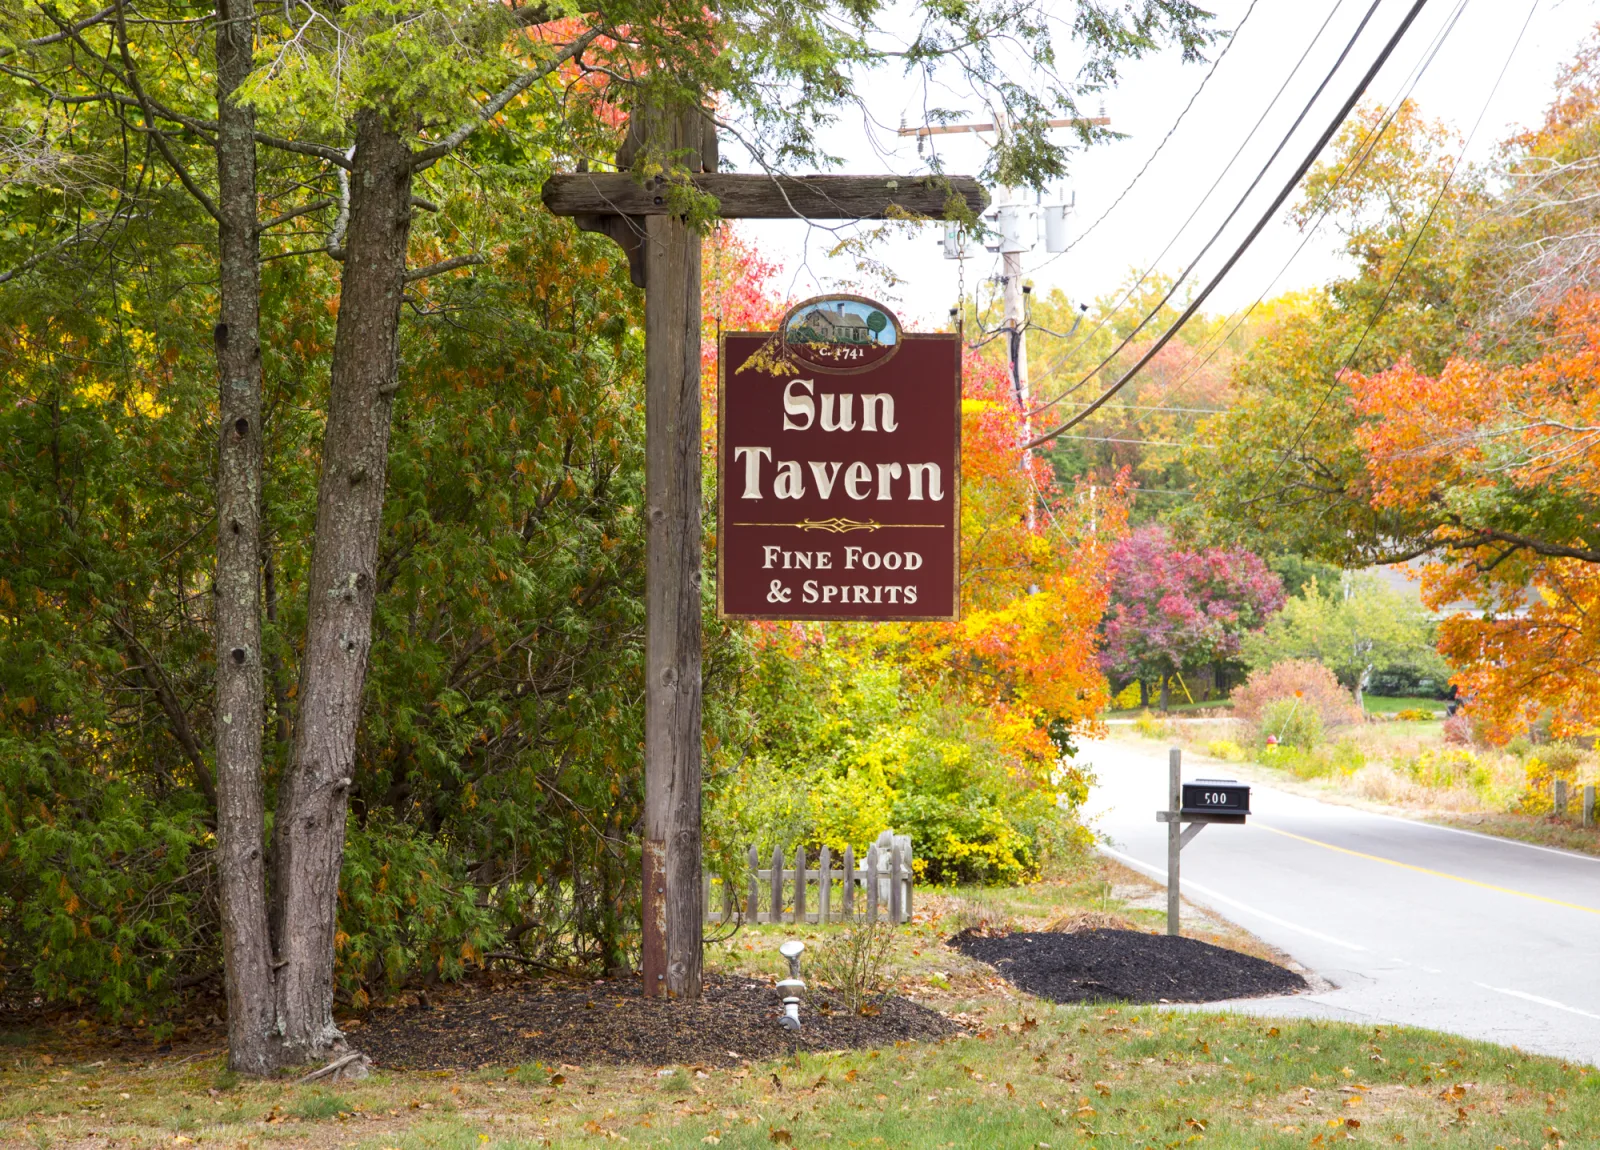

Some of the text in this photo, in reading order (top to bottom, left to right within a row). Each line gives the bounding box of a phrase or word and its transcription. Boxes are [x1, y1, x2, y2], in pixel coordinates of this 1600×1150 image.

[835, 347, 865, 360] 1741
[783, 378, 899, 433] Sun
[734, 446, 945, 502] Tavern
[761, 545, 924, 571] FINE FOOD
[766, 579, 918, 605] & SPIRITS
[1204, 792, 1227, 804] 500
